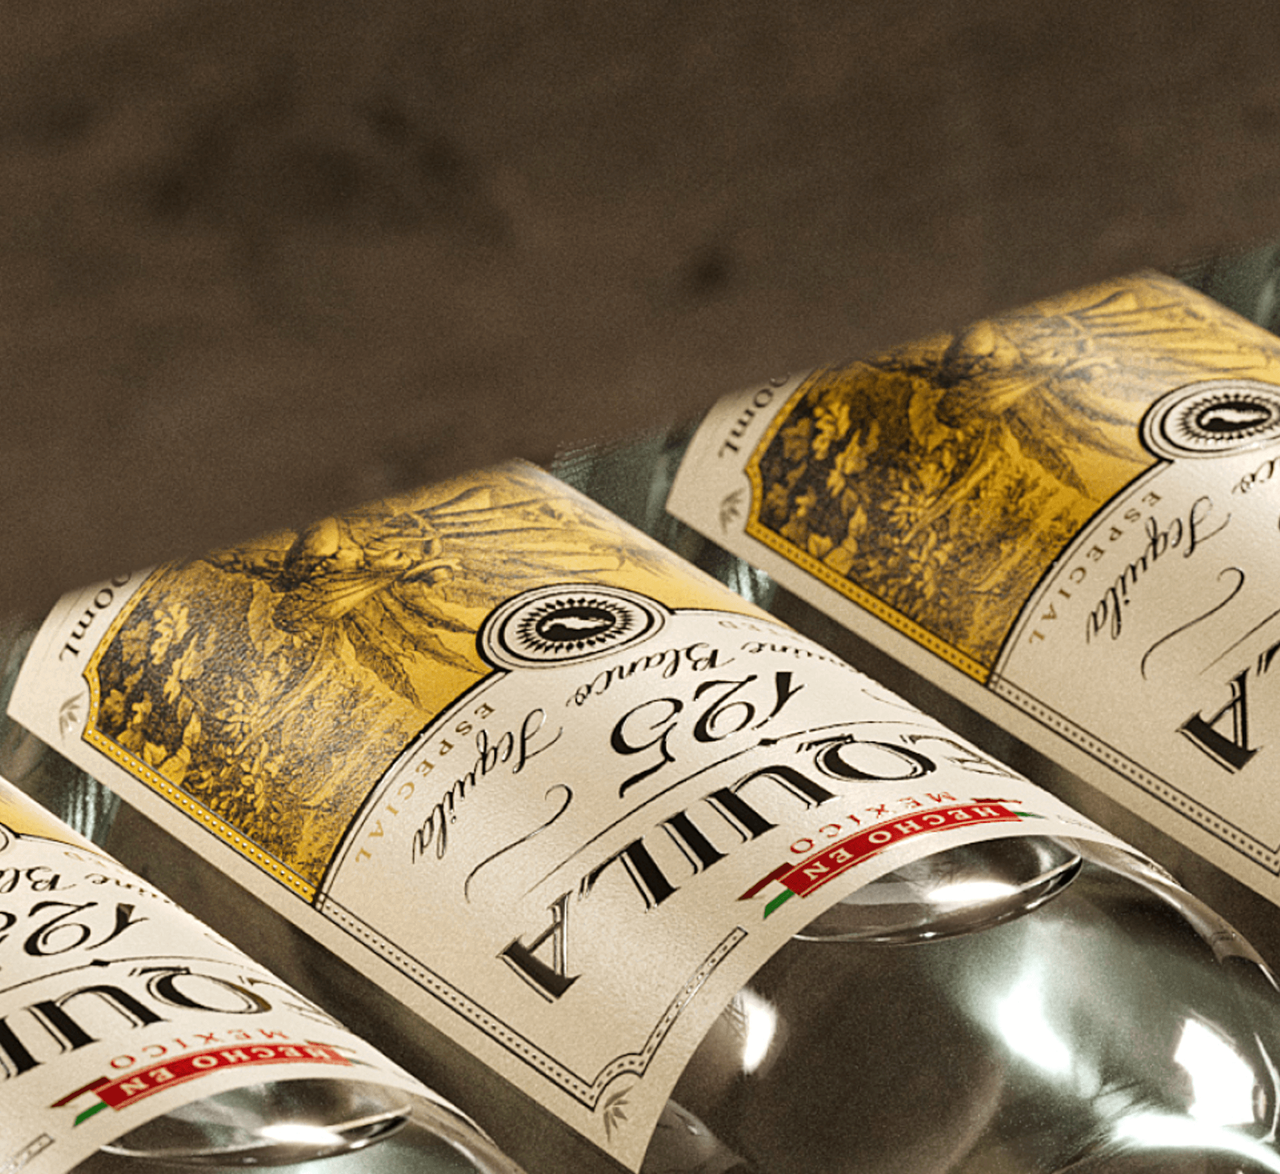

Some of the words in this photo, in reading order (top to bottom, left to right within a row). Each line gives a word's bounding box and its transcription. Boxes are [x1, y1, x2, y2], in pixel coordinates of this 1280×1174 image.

[1028, 489, 1161, 646] ESPECIAL
[1086, 495, 1232, 644] Tequila
[566, 642, 737, 708] Blanco
[610, 671, 806, 799] 125
[354, 702, 496, 865] ESPECIAL
[411, 707, 563, 864] Tequila
[789, 790, 957, 855] MEXICO
[867, 805, 1000, 845] HECHO
[807, 845, 853, 882] EN
[0, 901, 150, 956] 12
[111, 1027, 289, 1069] MEXICO
[192, 1045, 328, 1071] HECHO
[121, 1067, 173, 1097] EN
